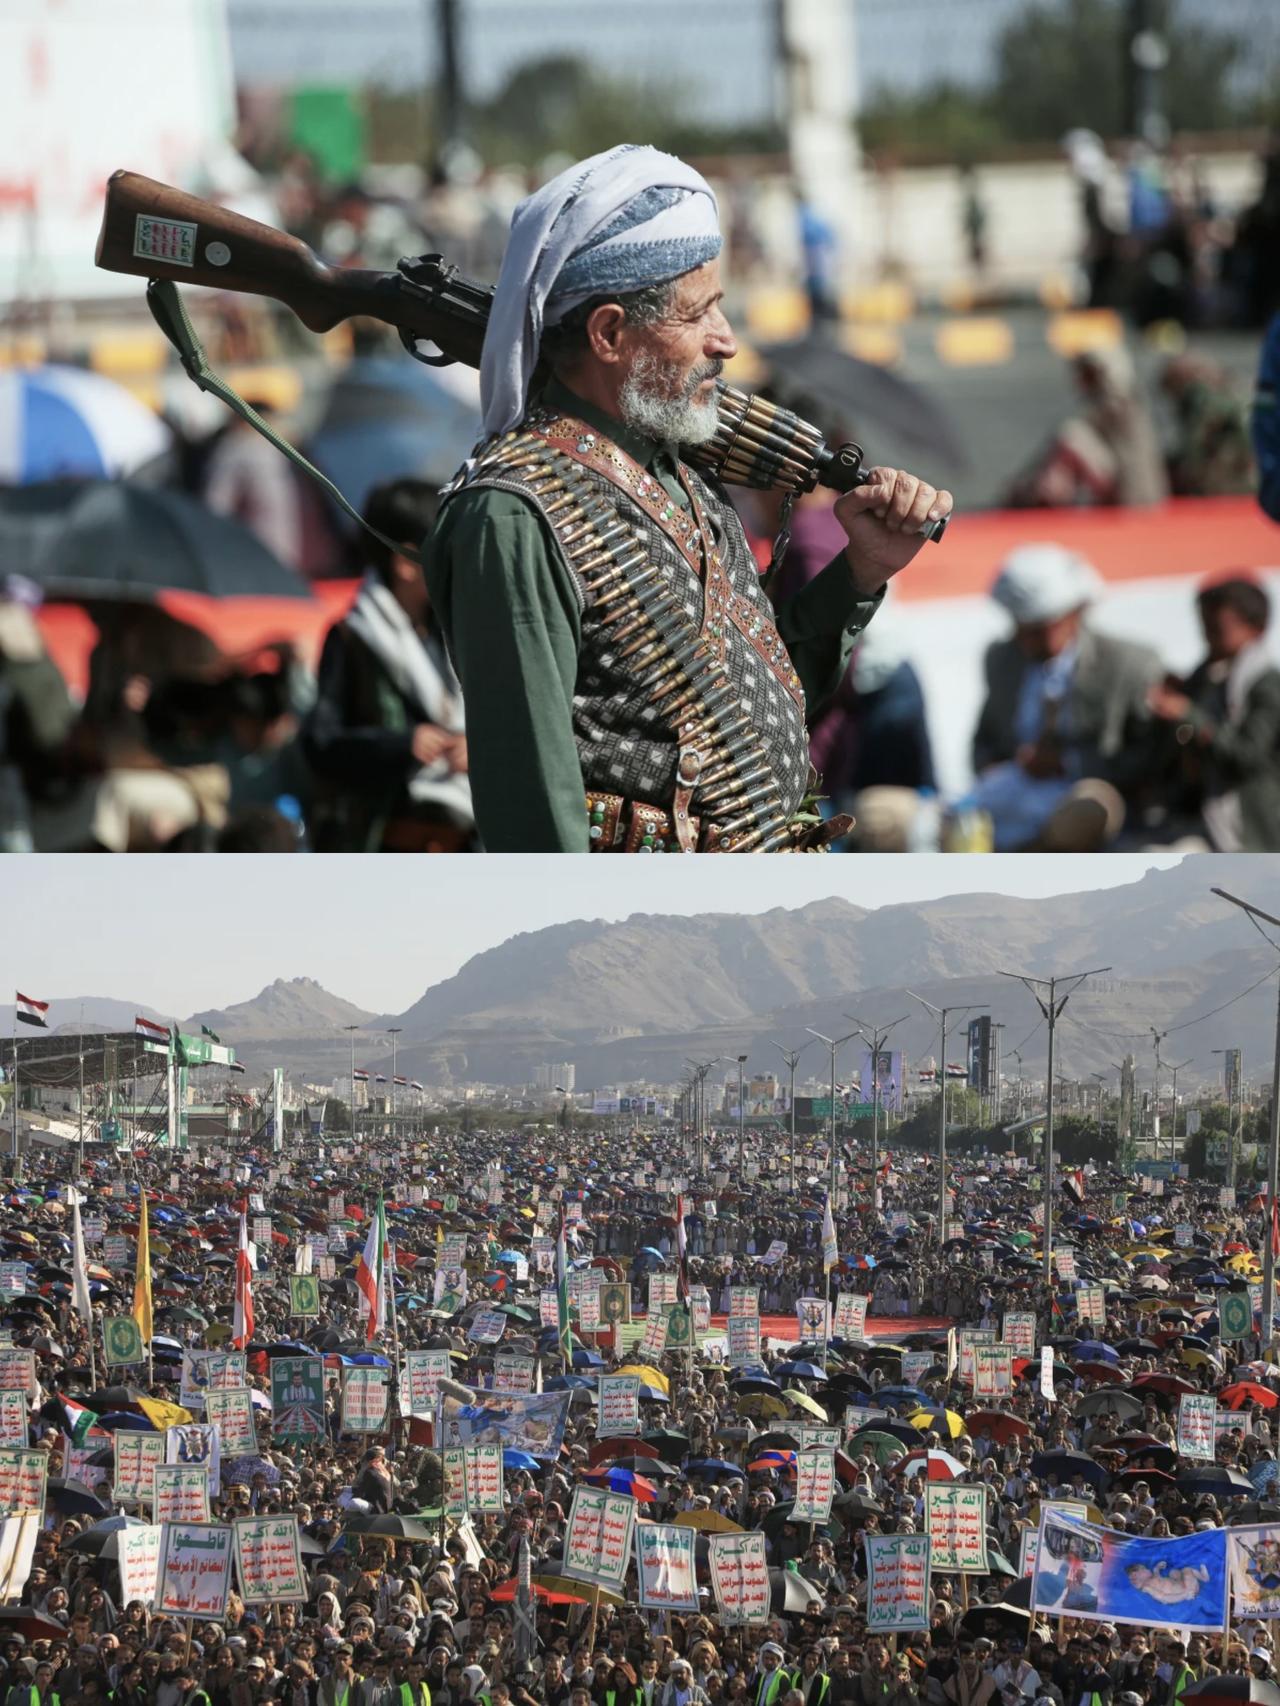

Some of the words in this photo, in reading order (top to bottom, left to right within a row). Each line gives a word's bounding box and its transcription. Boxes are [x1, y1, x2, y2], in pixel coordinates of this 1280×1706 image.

[961, 1490, 981, 1506] الله
[609, 1499, 630, 1517] الله
[272, 1522, 293, 1537] الله
[904, 1540, 926, 1556] الله
